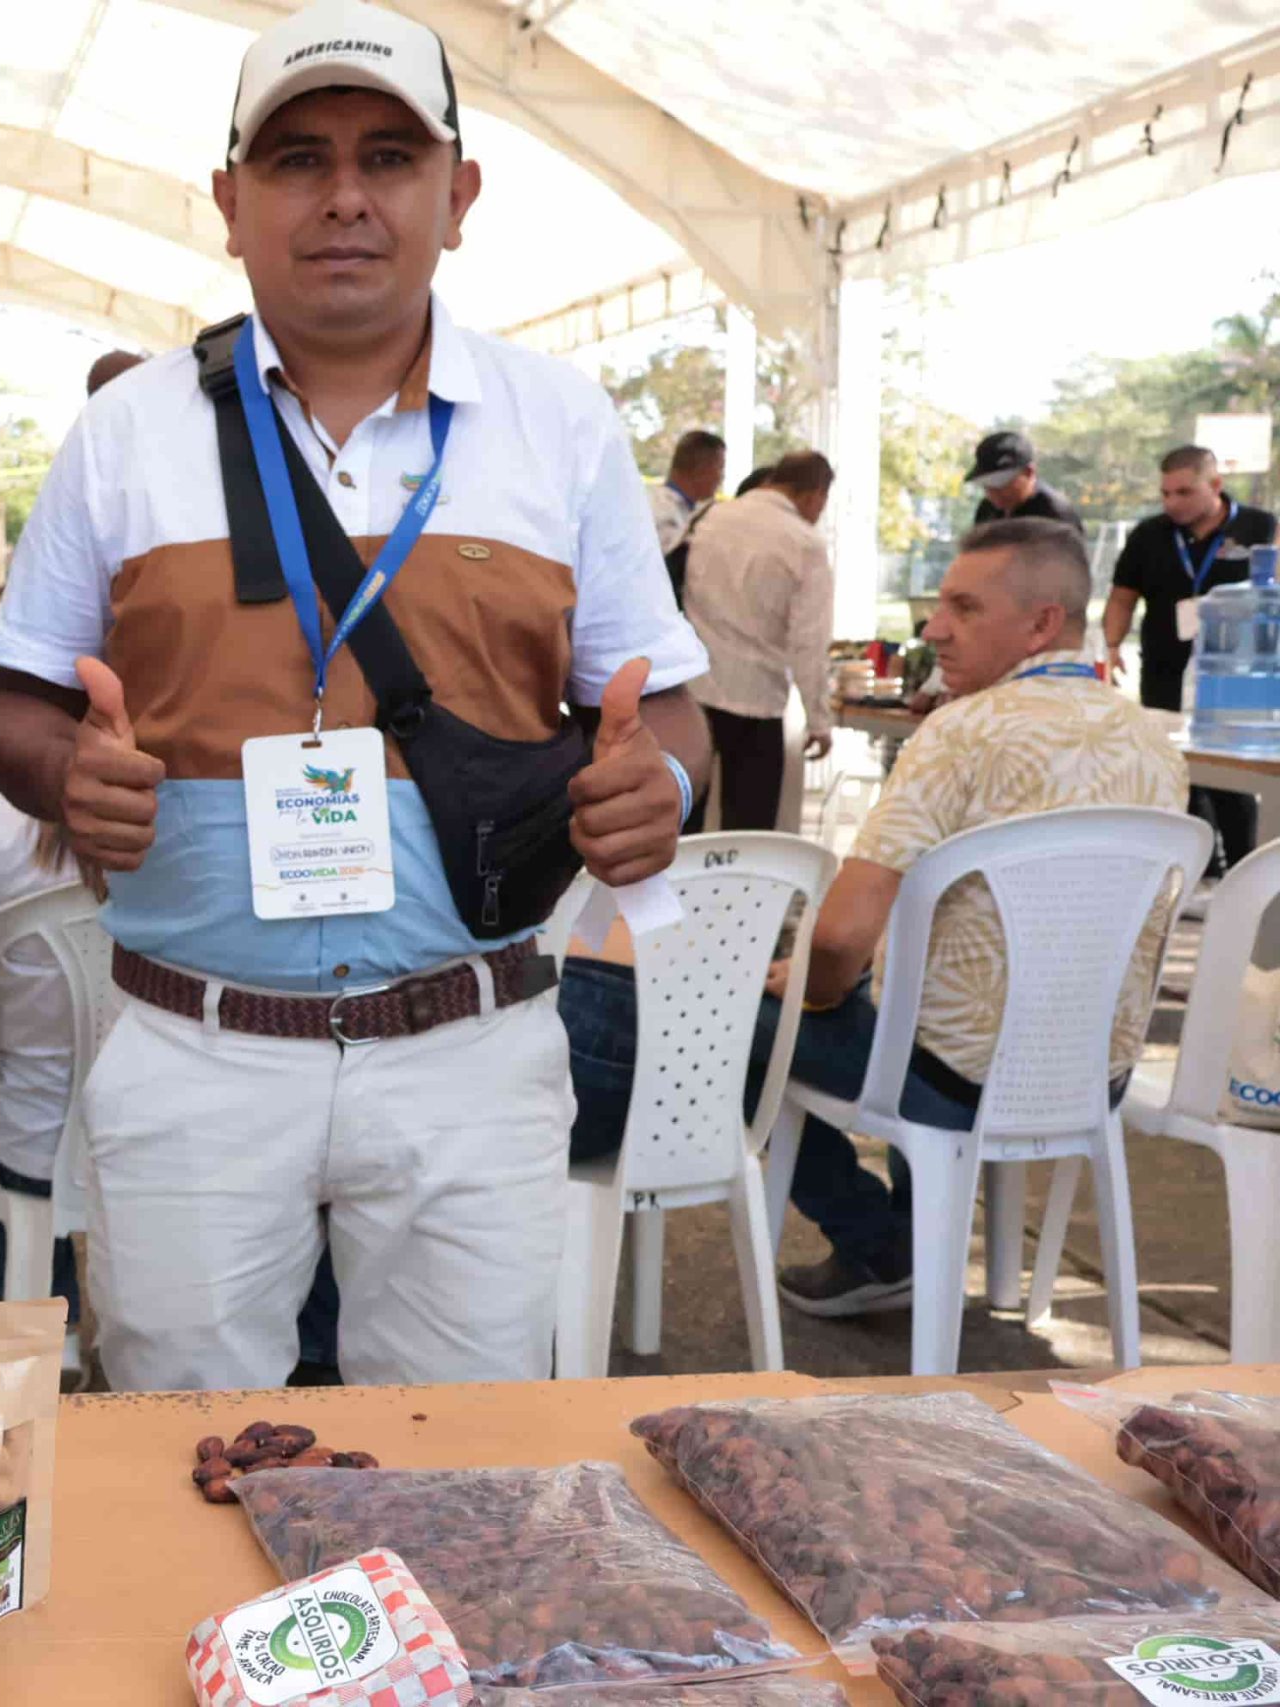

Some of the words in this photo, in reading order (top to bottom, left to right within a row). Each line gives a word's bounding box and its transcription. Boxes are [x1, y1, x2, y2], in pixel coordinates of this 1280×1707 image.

[283, 39, 393, 67] AMERICANINO
[294, 1597, 345, 1680] ASOLIRIOS
[323, 1590, 377, 1616] CHOCOLATE
[350, 1615, 381, 1665] ARTESANAL
[235, 1657, 274, 1686] ARAUCA
[256, 1652, 287, 1676] CACAO
[1126, 1648, 1265, 1676] ASOLIRIOS
[1156, 1678, 1239, 1702] ARTESANAL
[1238, 1666, 1278, 1701] CHOCOLATE
